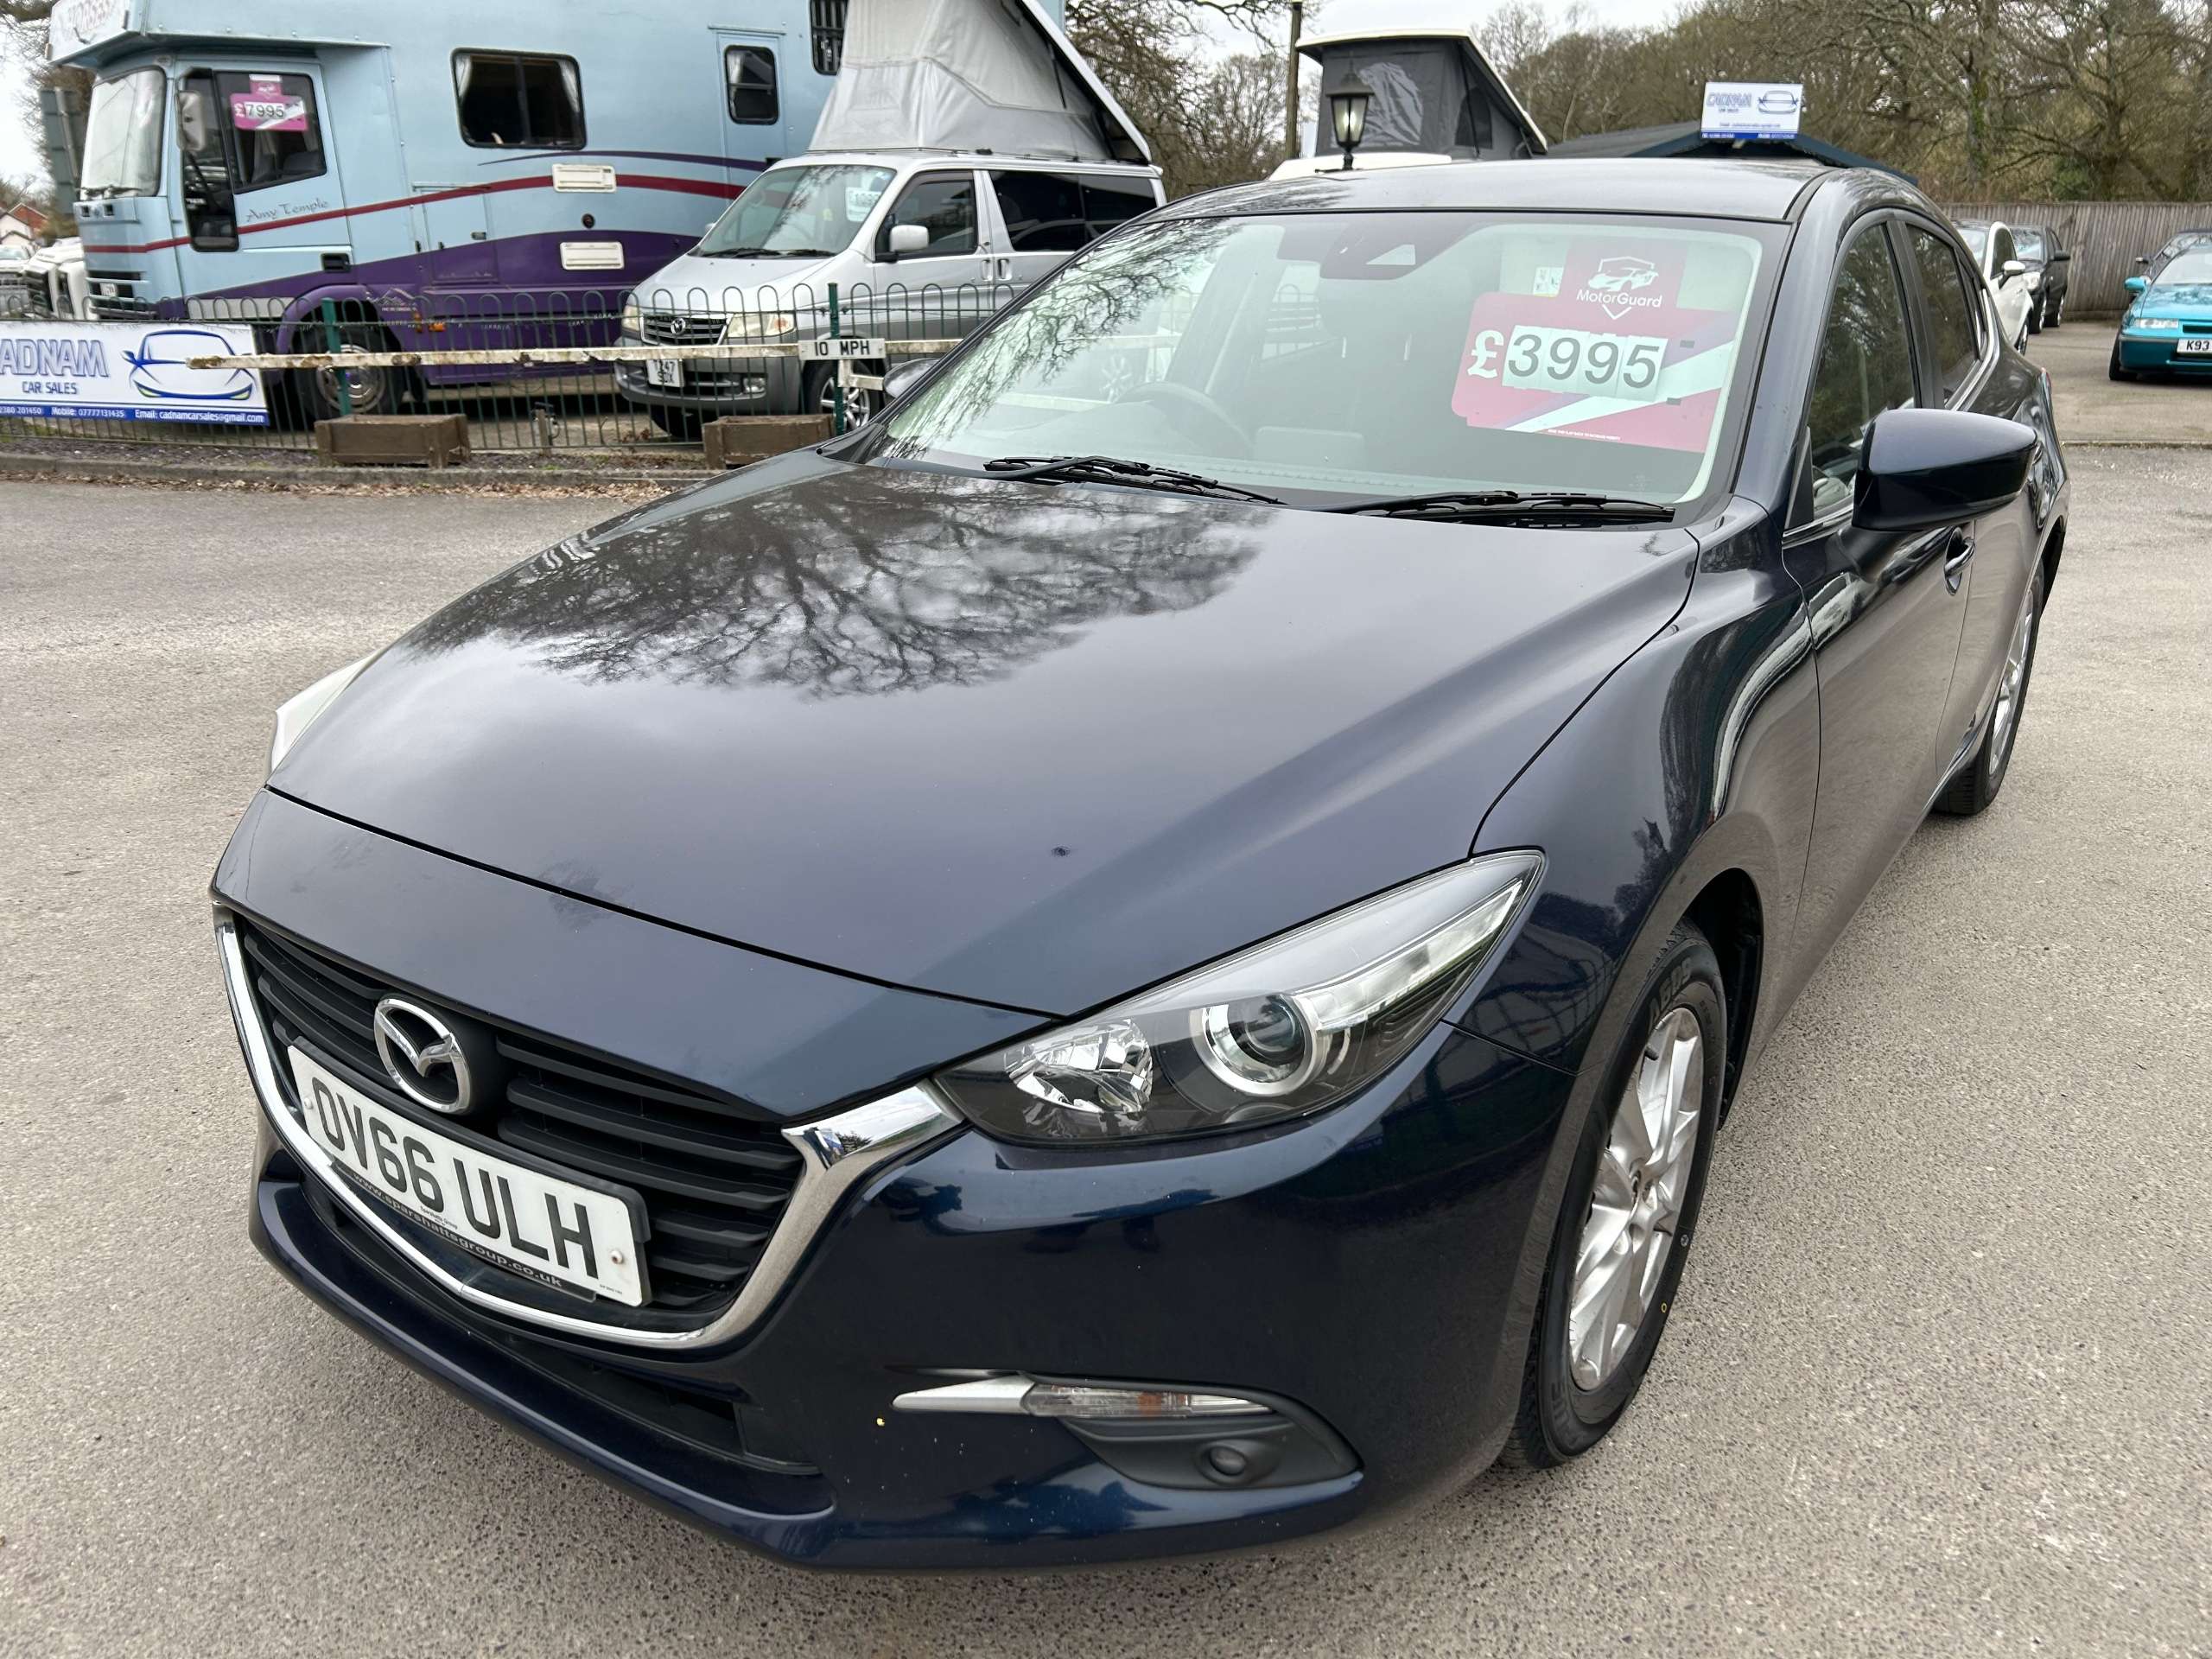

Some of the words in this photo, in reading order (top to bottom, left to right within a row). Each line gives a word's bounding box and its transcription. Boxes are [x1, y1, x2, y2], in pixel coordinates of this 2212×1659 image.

[234, 103, 284, 118] £7995
[245, 208, 277, 222] Amy
[277, 198, 329, 215] Temple
[1576, 289, 1662, 308] MotorGuard
[814, 341, 829, 356] 10
[840, 340, 870, 355] MPH
[2186, 340, 2210, 352] K93
[1467, 329, 1660, 389] £3995
[22, 381, 41, 393] CAR
[45, 382, 78, 395] SALES
[52, 406, 76, 416] Mobile:
[135, 409, 158, 419] Email:
[159, 411, 264, 423] cadnamcarsales@gmail.com
[312, 1077, 444, 1213] OV66
[453, 1157, 598, 1280] ULH
[353, 1172, 563, 1287] www.sparshattsgroup.co.uk
